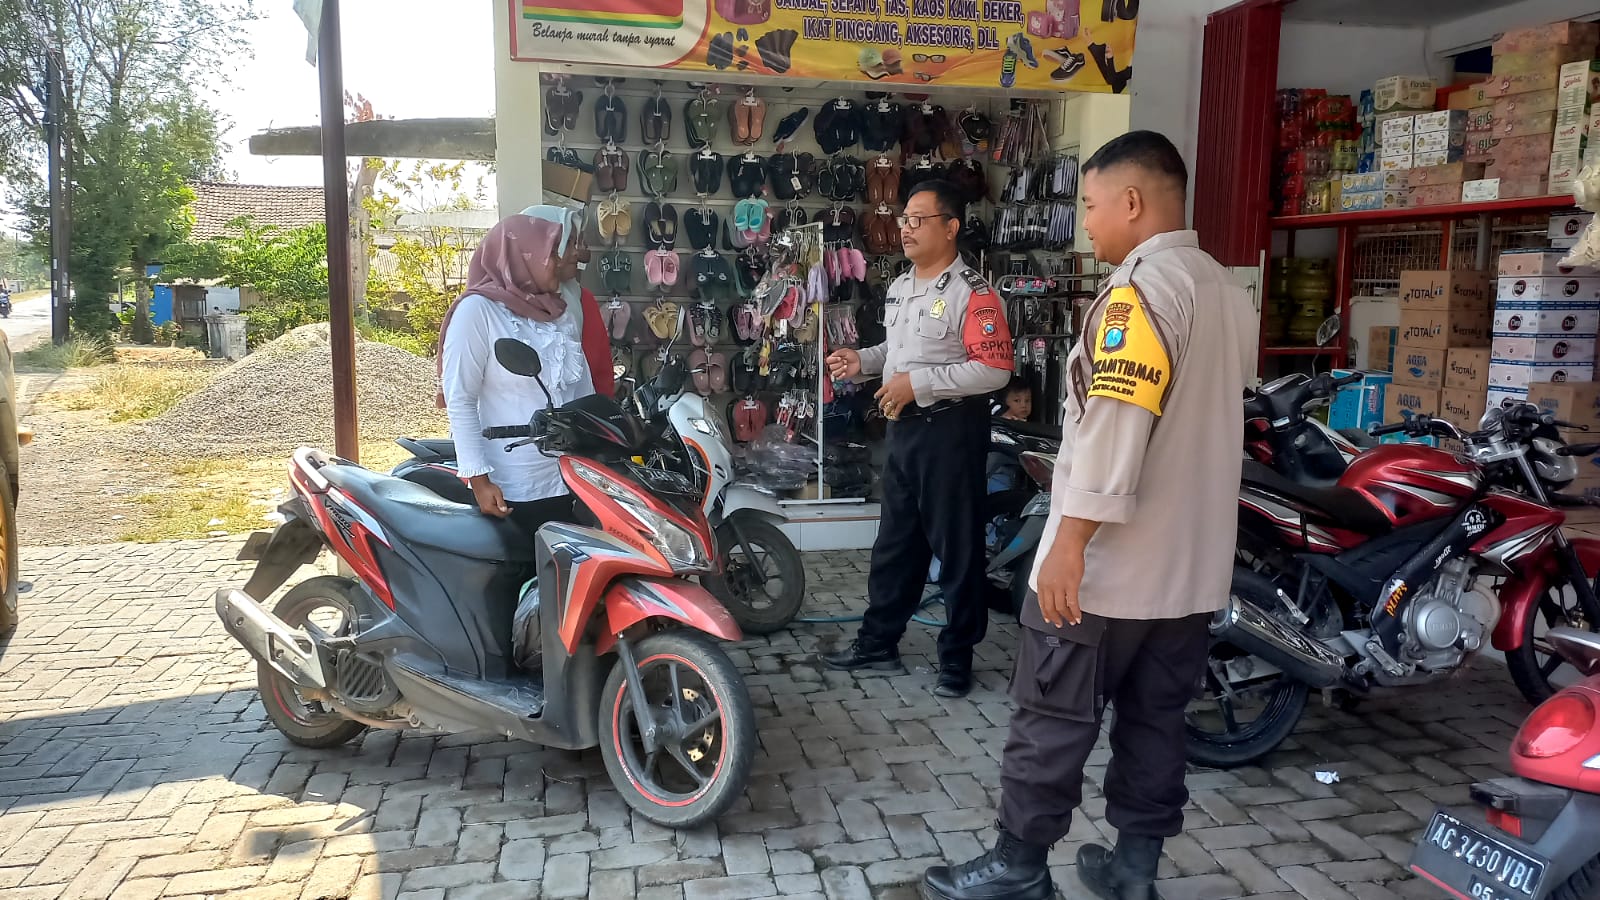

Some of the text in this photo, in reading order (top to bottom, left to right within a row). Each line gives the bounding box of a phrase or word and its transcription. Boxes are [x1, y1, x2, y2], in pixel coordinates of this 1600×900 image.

[912, 0, 945, 19] KAOS
[948, 0, 980, 25] KAKI,
[983, 0, 1025, 28] DEKER,
[532, 22, 676, 48] Belanja murah tanpa syarat
[802, 16, 999, 53] IKAT PINGGANG, AKSESORIS, DLL
[1410, 279, 1435, 299] TOTAL
[1409, 319, 1434, 338] TOTAL
[1406, 354, 1427, 367] AQUA
[1396, 393, 1421, 410] AQUA
[608, 526, 645, 552] HONDA
[1431, 823, 1535, 895] AG 3430 VBL
